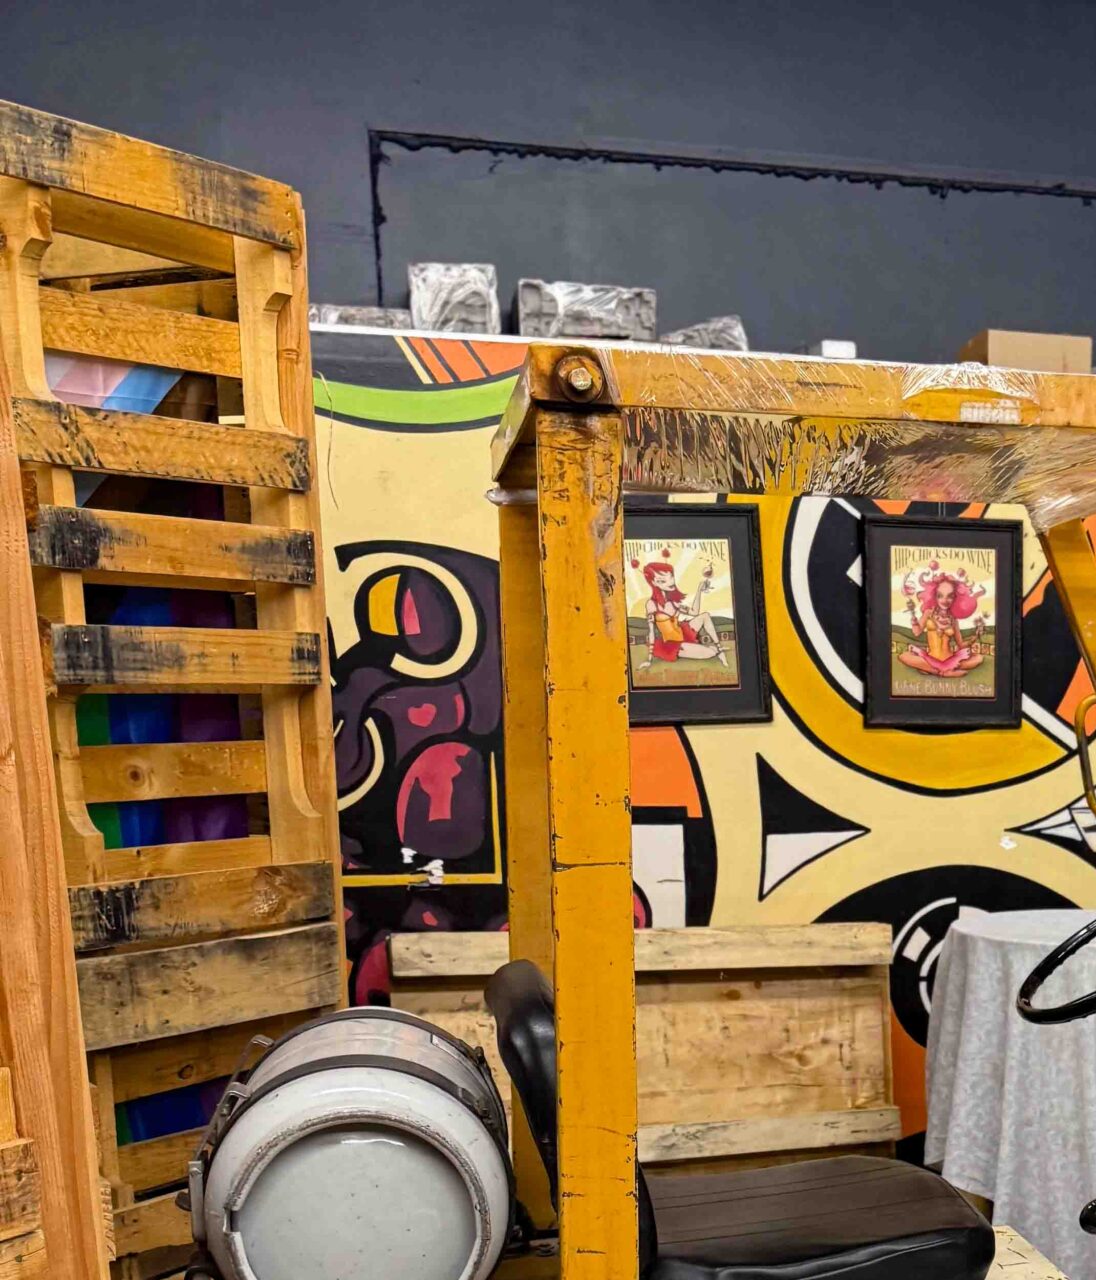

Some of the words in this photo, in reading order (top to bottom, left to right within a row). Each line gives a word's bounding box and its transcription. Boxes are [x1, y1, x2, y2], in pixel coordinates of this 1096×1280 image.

[698, 541, 726, 562] WINE
[894, 547, 911, 571] HIP
[912, 548, 947, 562] CHICKS
[949, 549, 965, 561] DO
[966, 549, 993, 574] WINE
